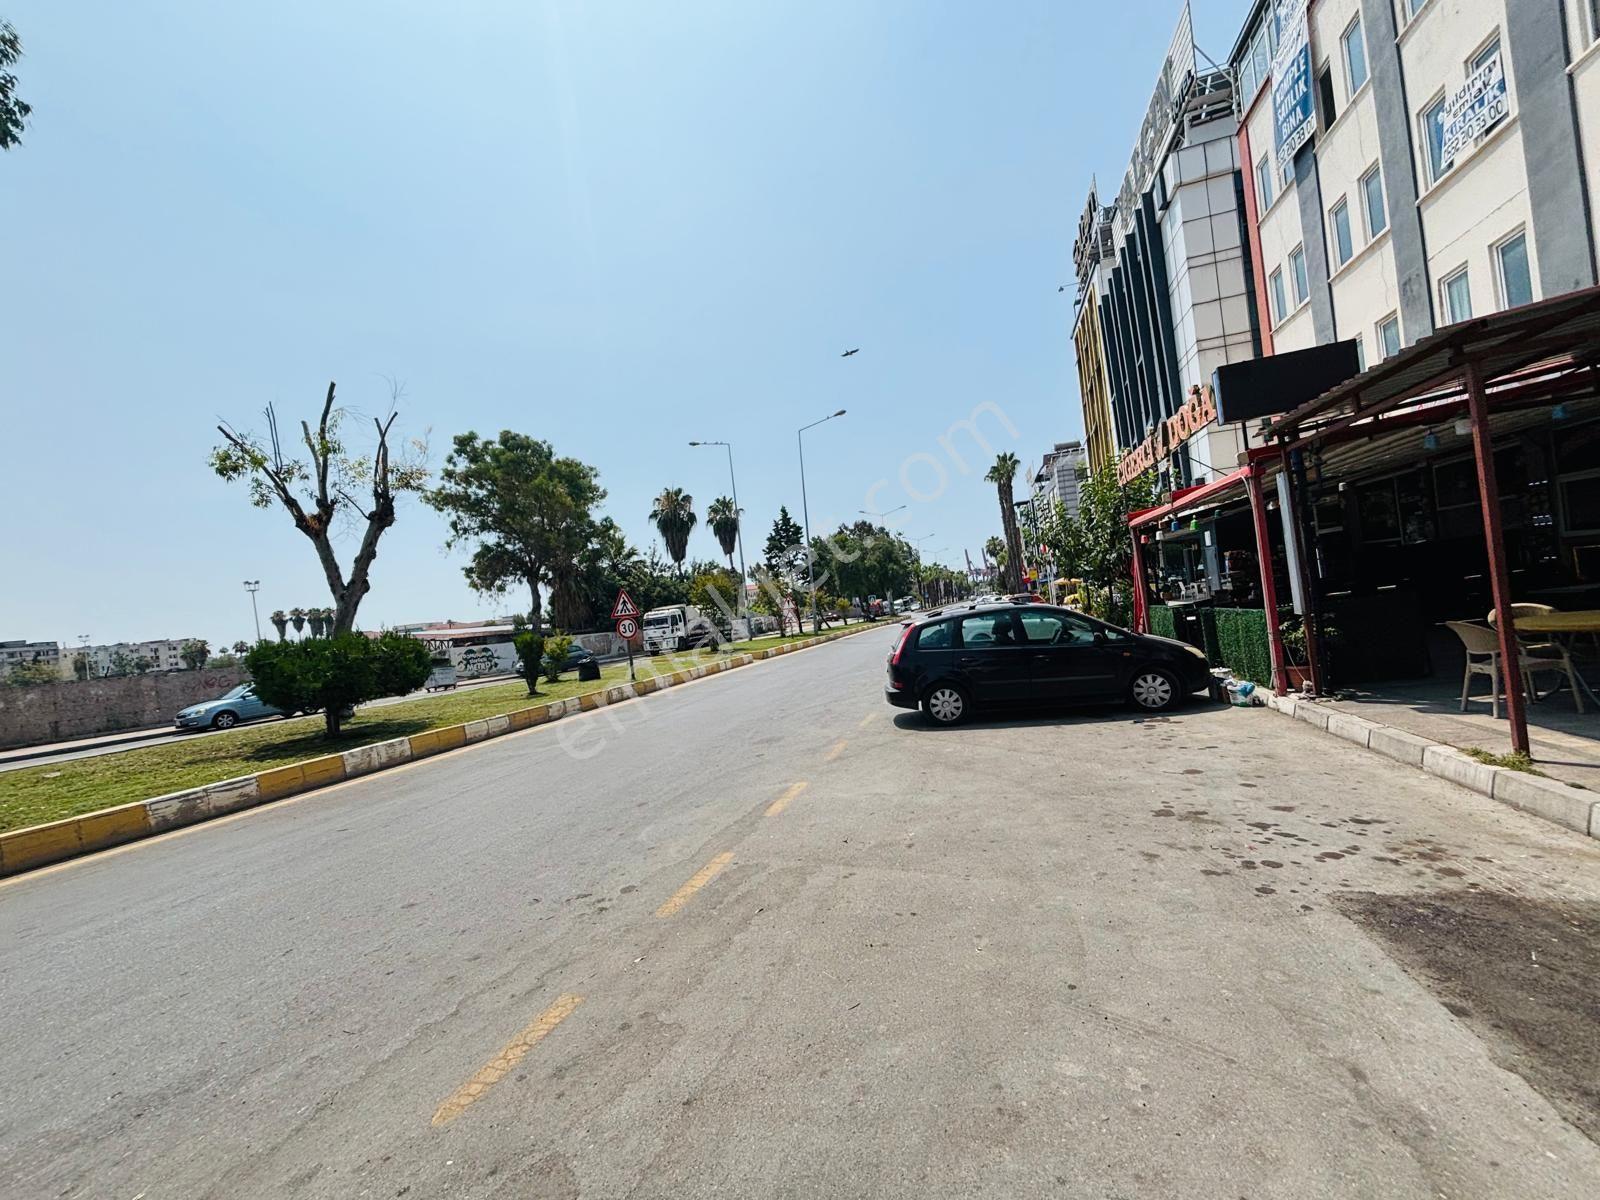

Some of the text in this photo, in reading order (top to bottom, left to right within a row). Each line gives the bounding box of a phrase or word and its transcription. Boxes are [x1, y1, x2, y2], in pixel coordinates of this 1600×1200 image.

[1278, 75, 1307, 126] SATILIK
[1453, 78, 1491, 119] emlak
[1489, 100, 1503, 120] 00
[621, 623, 634, 634] 30
